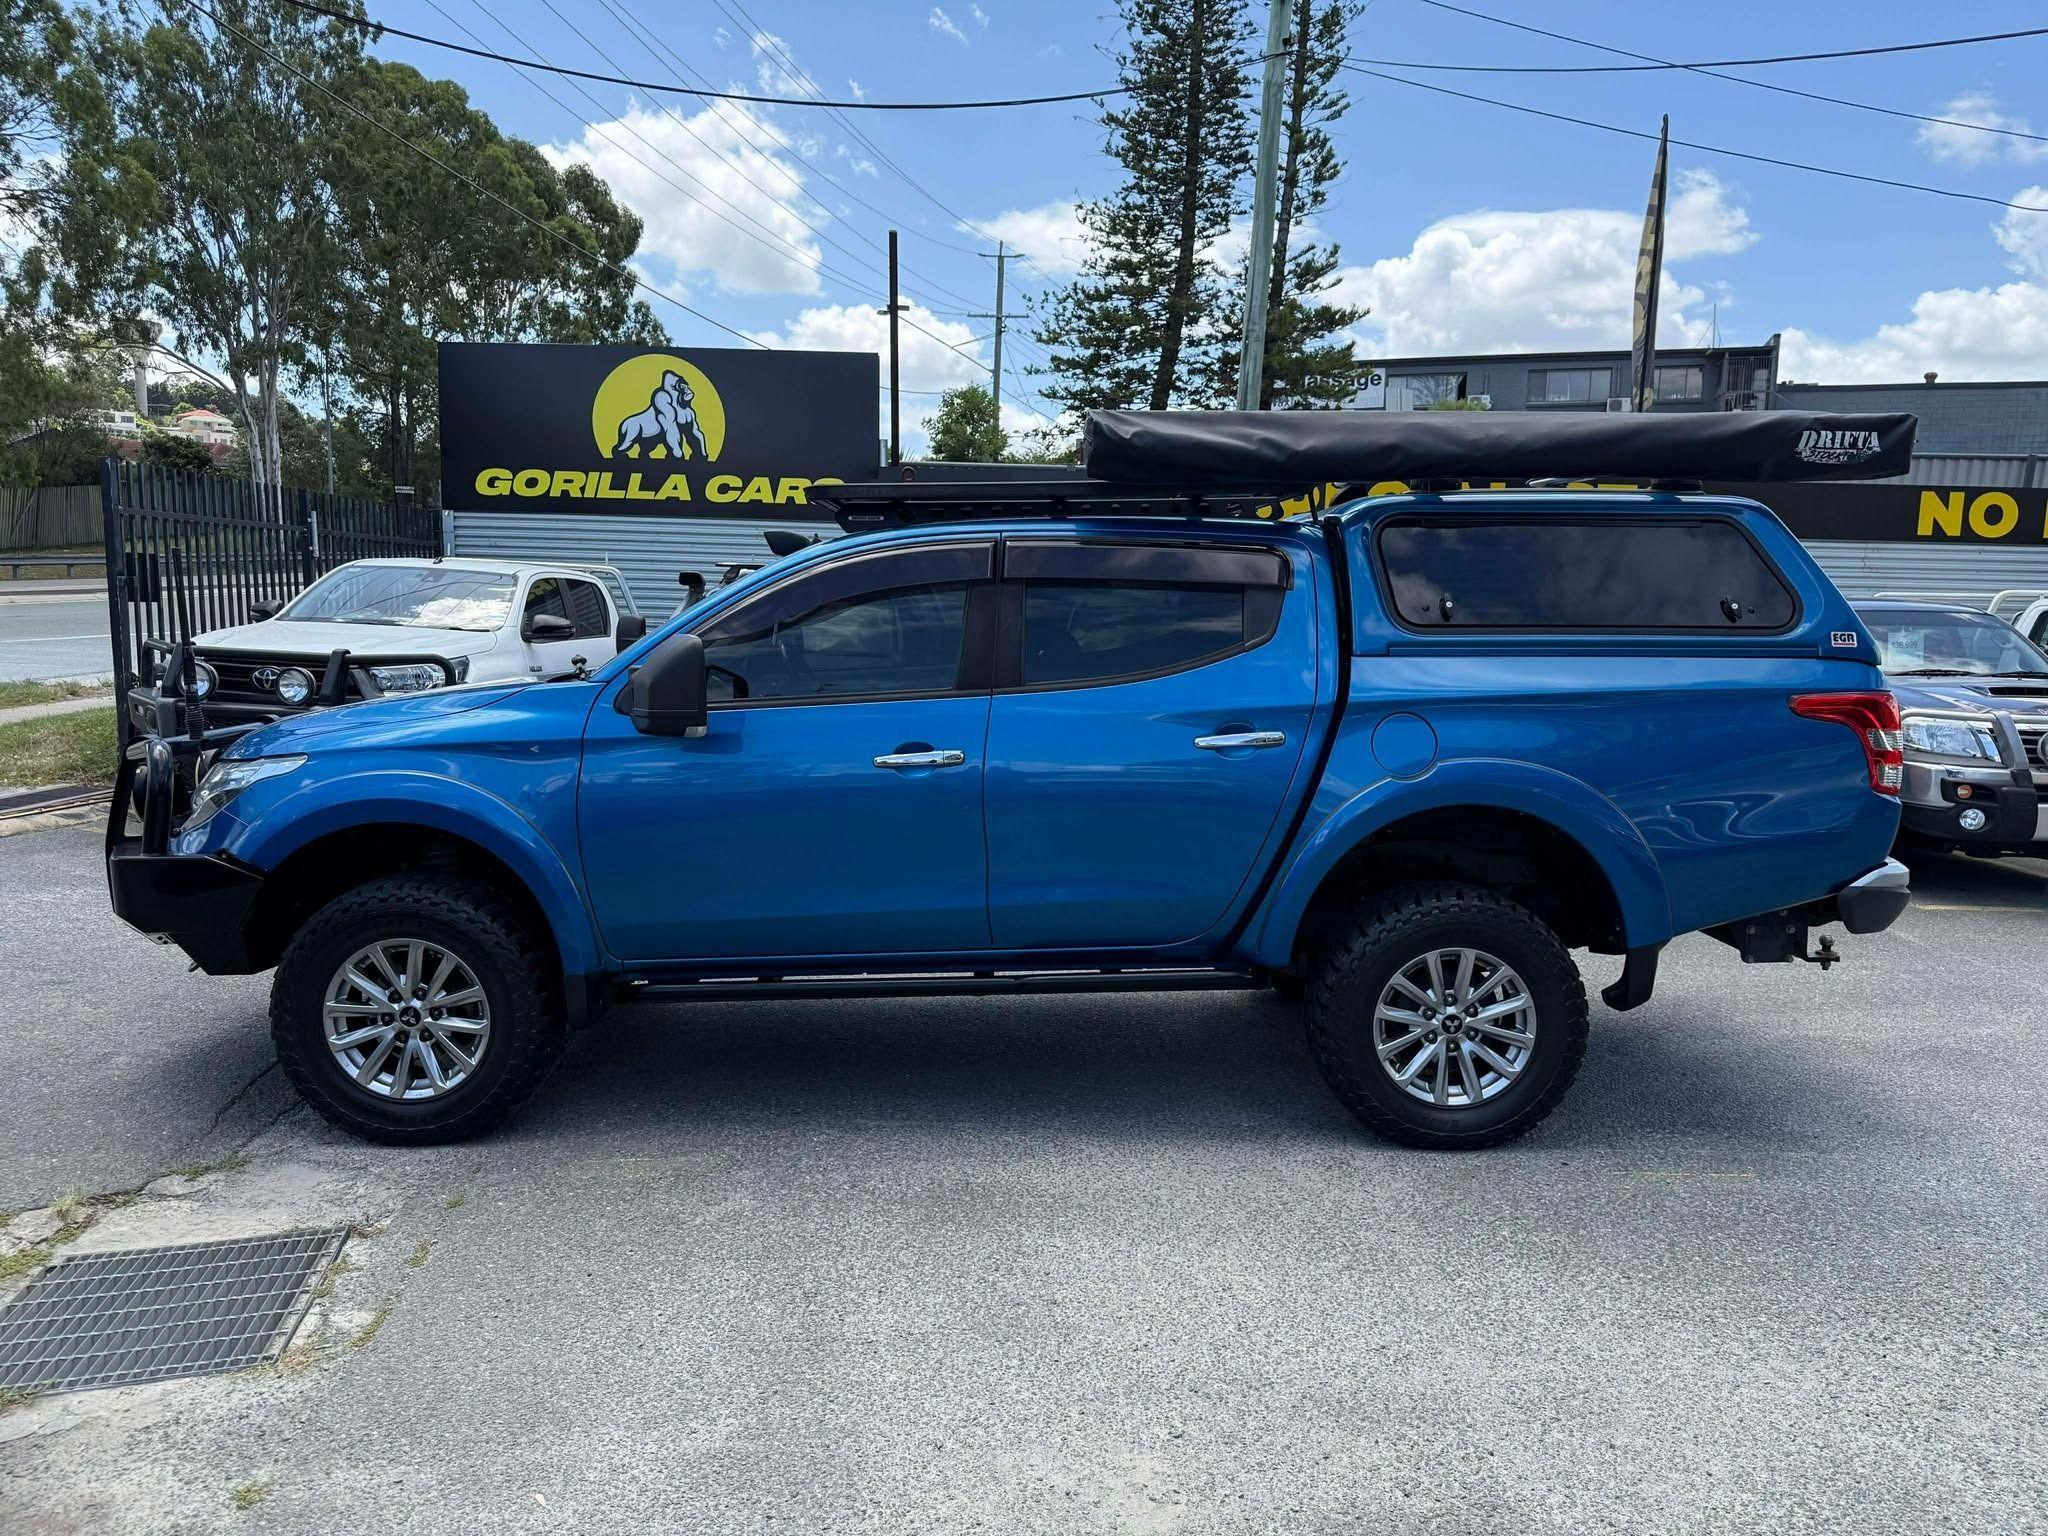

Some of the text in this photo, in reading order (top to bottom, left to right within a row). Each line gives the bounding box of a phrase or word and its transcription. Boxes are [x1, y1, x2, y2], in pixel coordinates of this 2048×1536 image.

[1798, 430, 1881, 451] DRIFTA
[475, 468, 846, 505] GORILLA CAR
[1917, 490, 2019, 539] NO
[1833, 632, 1856, 643] EGR
